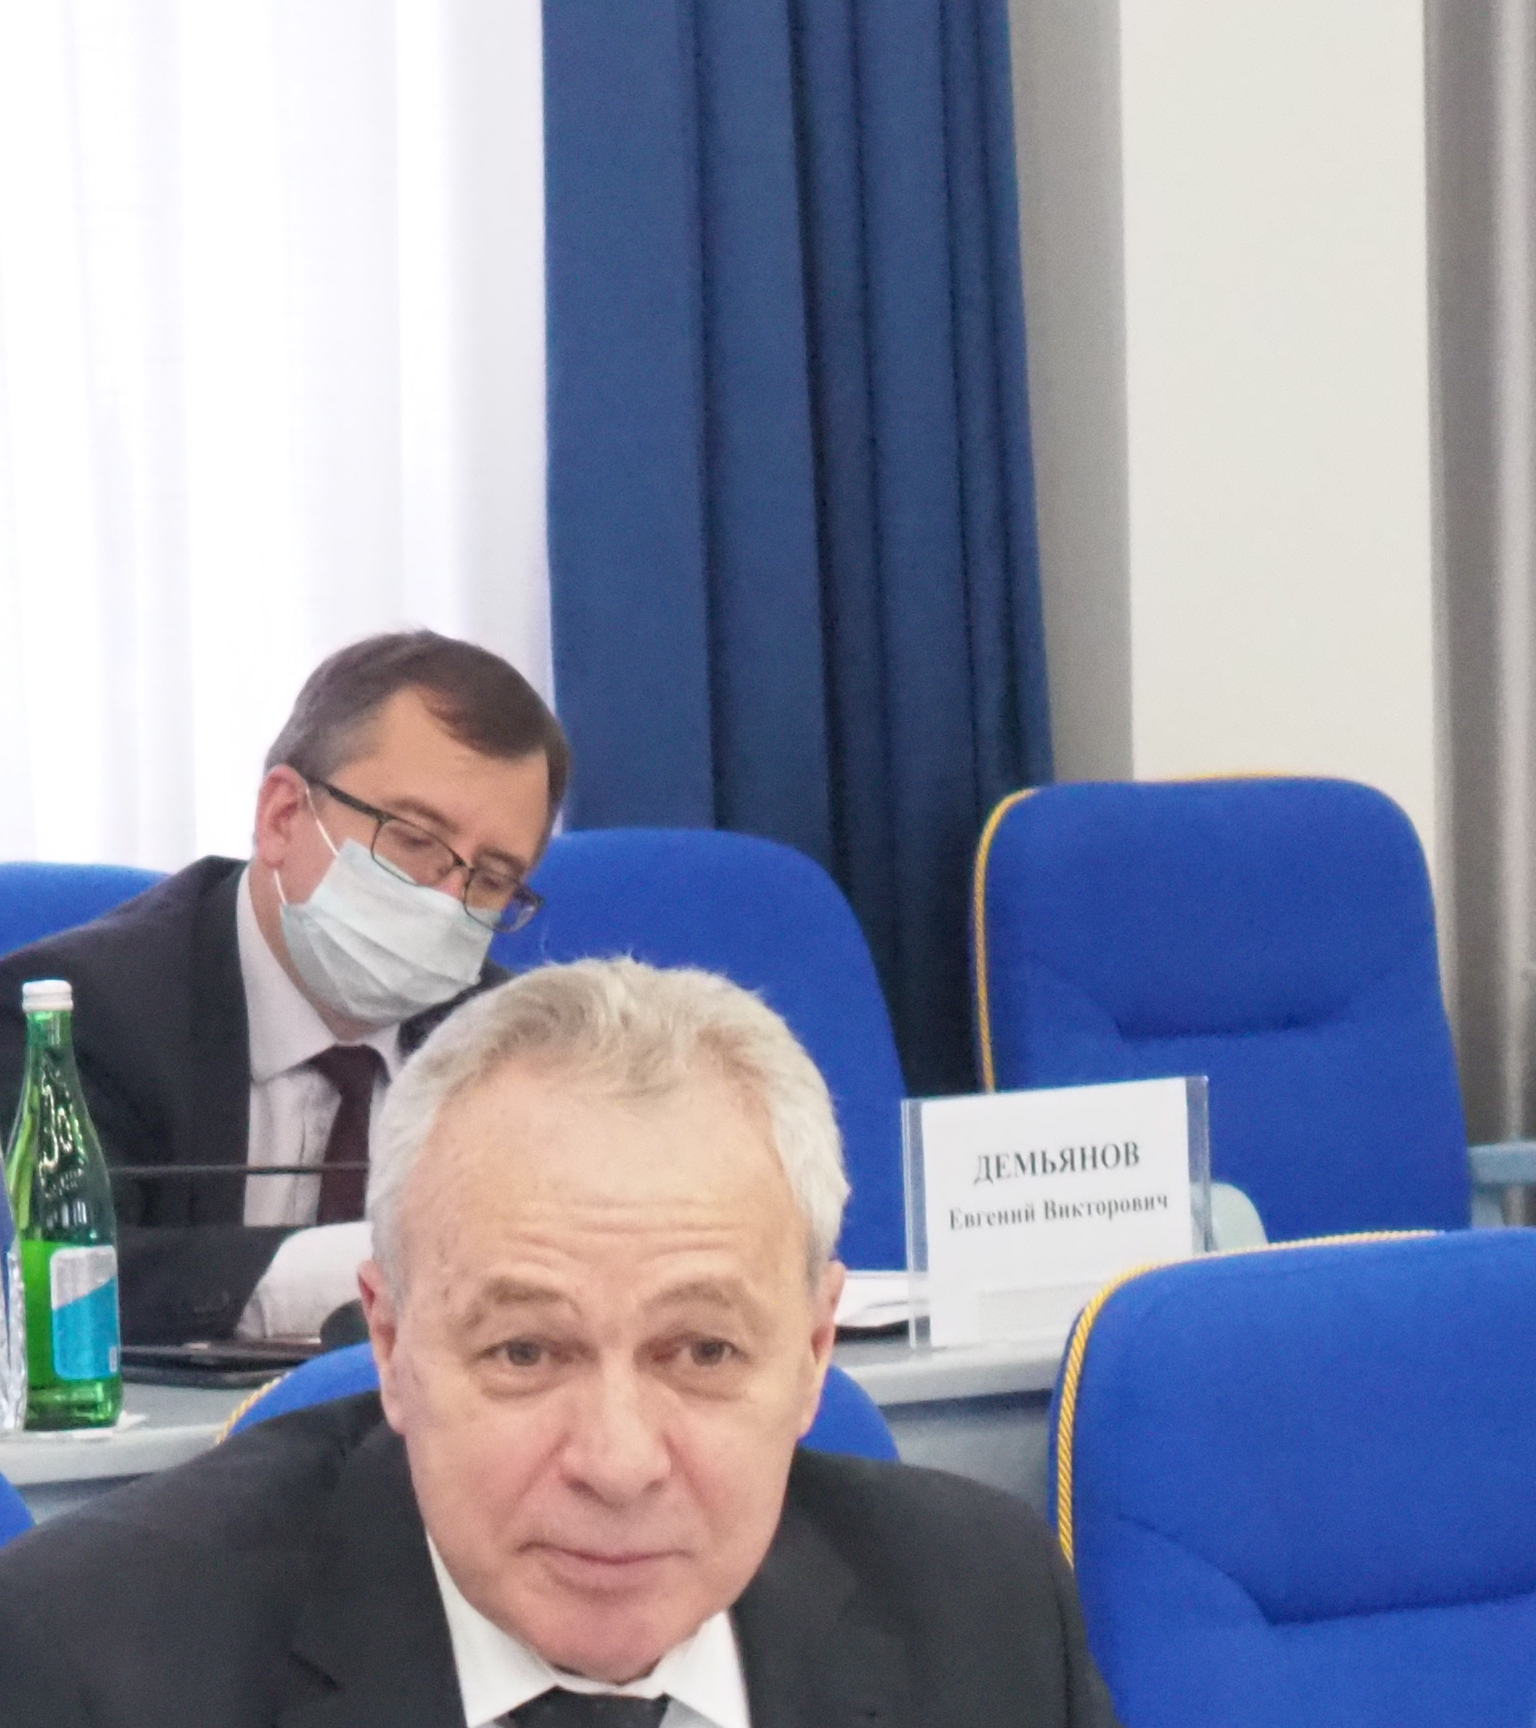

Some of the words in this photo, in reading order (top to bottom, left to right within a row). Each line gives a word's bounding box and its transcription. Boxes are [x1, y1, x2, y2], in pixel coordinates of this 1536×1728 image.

[973, 1141, 1141, 1185] ДЕМЬЯНОВ
[948, 1204, 1036, 1231] Евгений
[1043, 1193, 1169, 1222] Викторович
